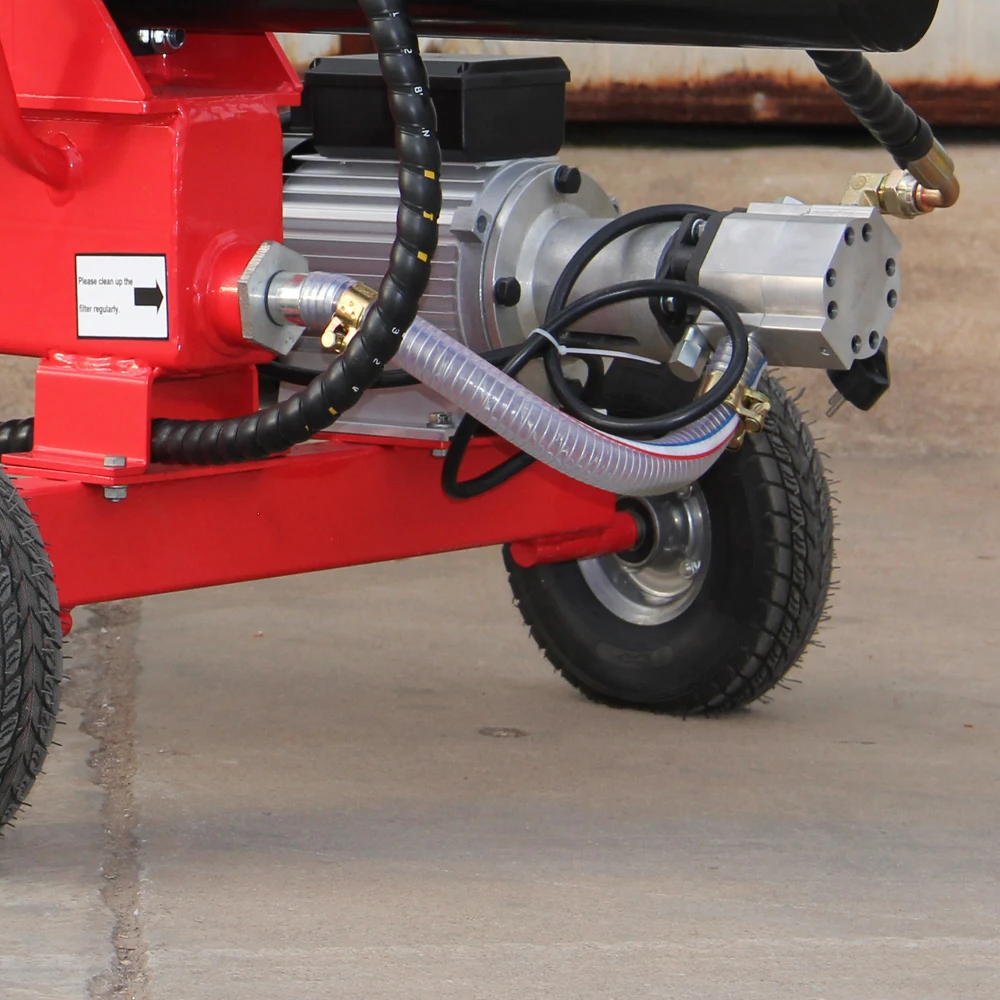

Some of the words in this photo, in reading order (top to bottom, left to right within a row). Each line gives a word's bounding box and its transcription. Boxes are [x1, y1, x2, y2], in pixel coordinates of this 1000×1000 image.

[78, 276, 97, 285] Please
[98, 277, 114, 285] clean
[115, 279, 122, 287] up
